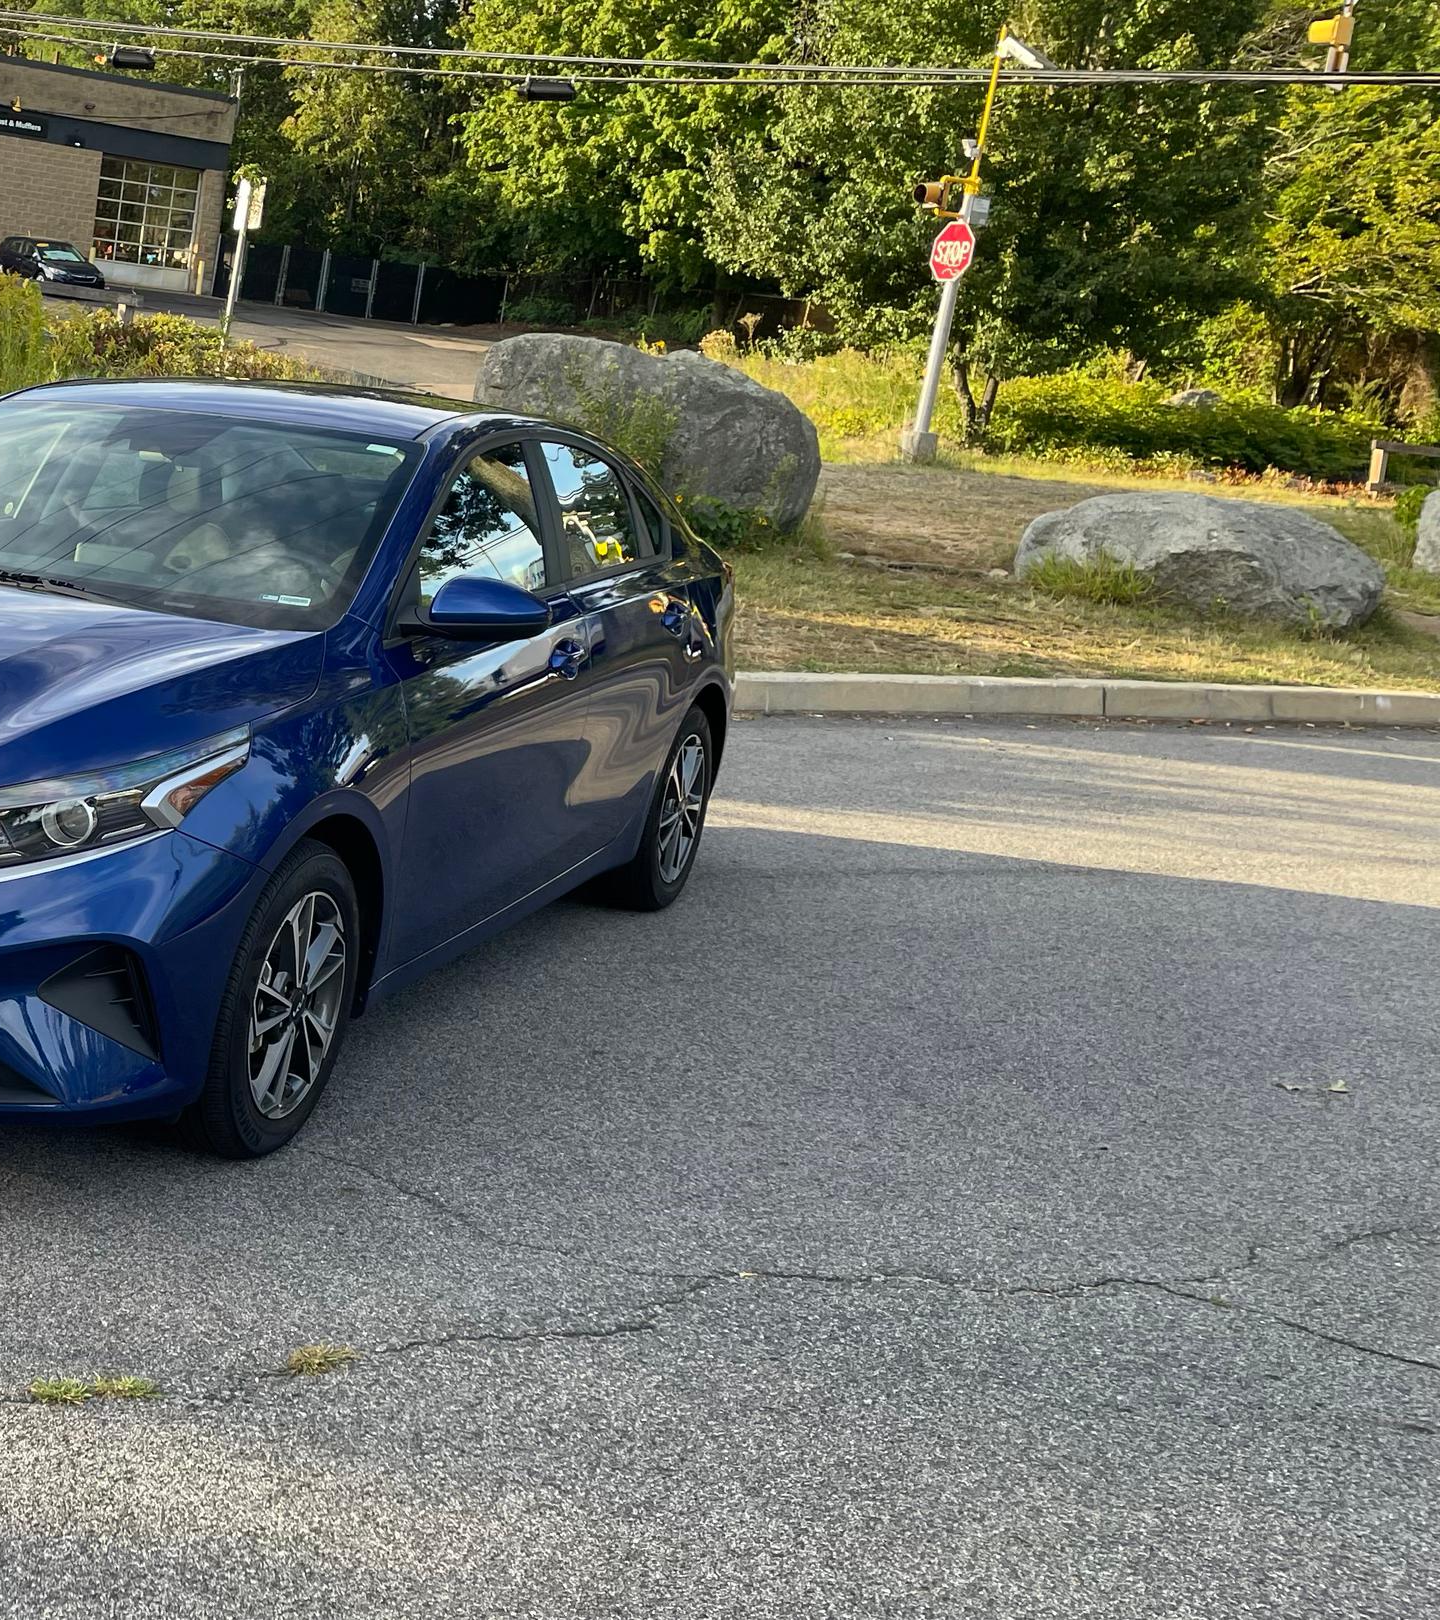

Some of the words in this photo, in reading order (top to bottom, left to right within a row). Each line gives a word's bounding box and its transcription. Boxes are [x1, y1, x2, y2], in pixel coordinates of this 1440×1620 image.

[8, 119, 15, 127] &
[15, 120, 42, 132] Mufflers
[934, 240, 971, 265] STOP
